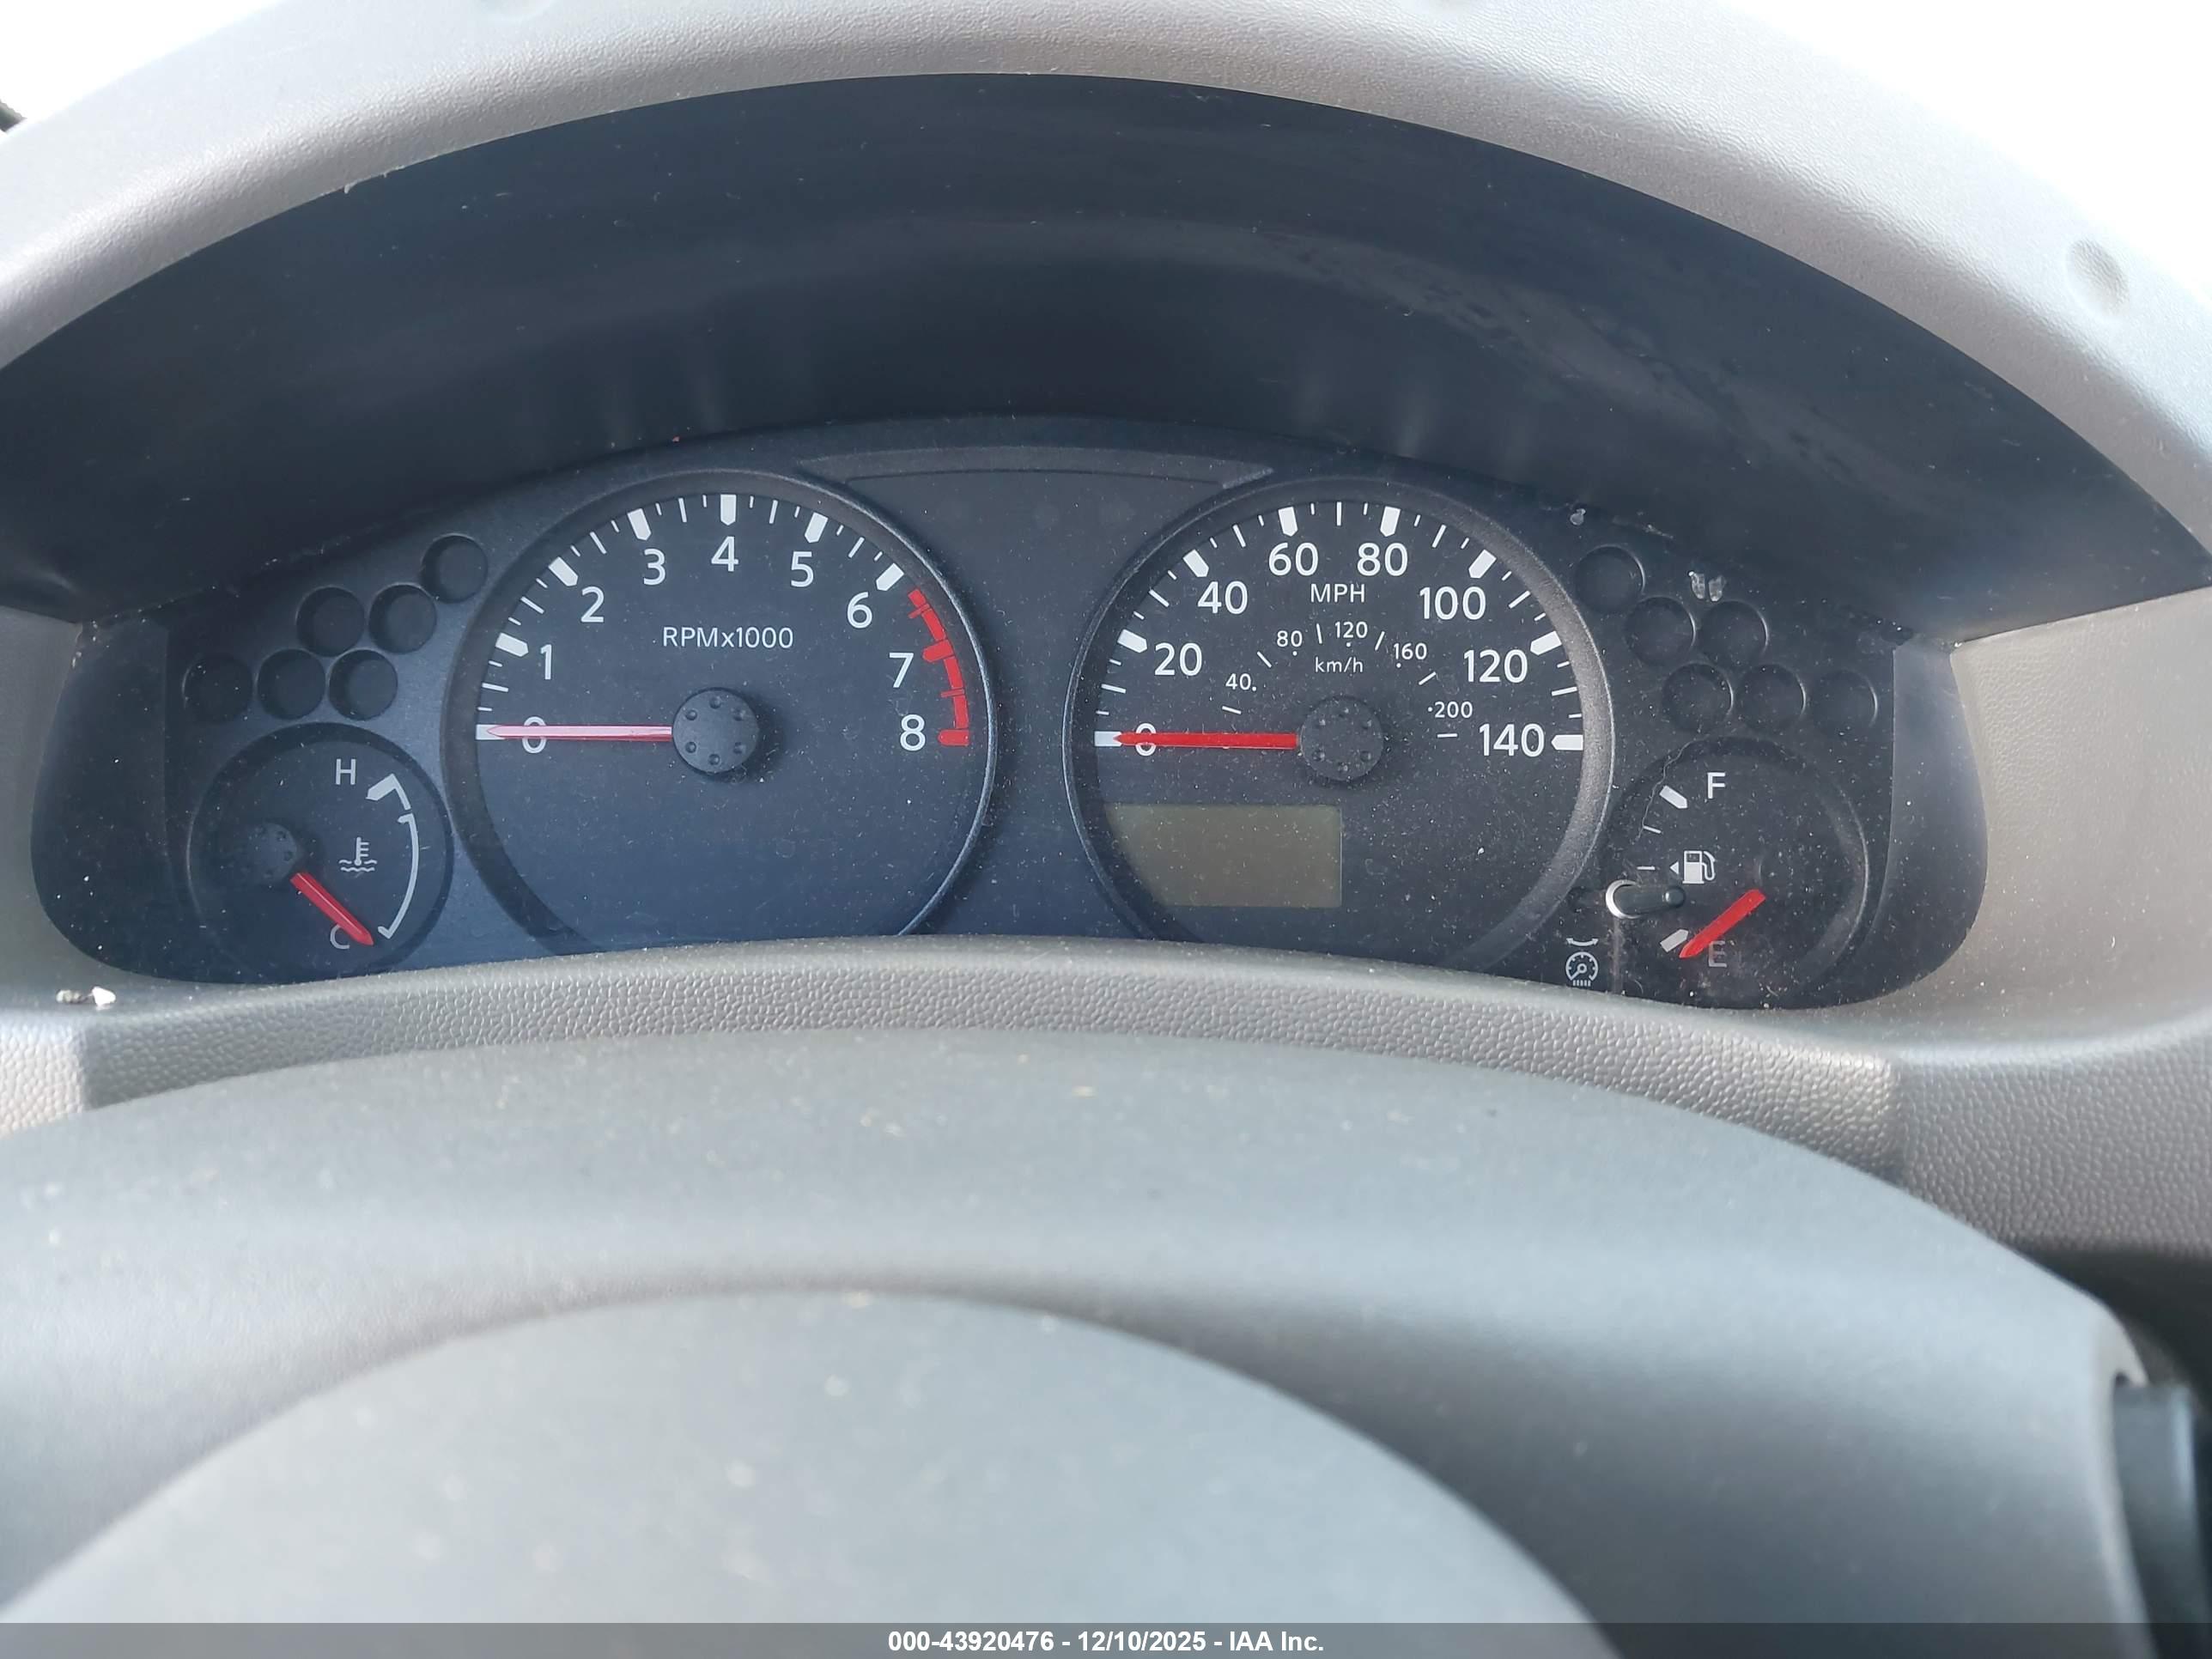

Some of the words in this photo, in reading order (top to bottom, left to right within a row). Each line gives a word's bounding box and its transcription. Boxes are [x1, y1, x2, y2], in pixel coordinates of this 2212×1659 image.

[643, 548, 666, 586] 3
[711, 536, 739, 572] 4
[791, 550, 814, 587] 5
[1268, 542, 1319, 576] 60
[1357, 542, 1408, 576] 80
[580, 586, 605, 623] 2
[1197, 580, 1248, 615] 40
[1310, 583, 1365, 603] MPH
[1419, 586, 1486, 620] 100
[847, 592, 872, 629] 6
[663, 626, 793, 648] RPMx1000
[1276, 630, 1303, 647] 80
[1334, 621, 1368, 639] 120
[540, 644, 552, 680] 1
[1154, 642, 1202, 677] 20
[1315, 656, 1363, 672] km/h
[1394, 642, 1427, 660] 160
[1463, 649, 1528, 684] 120
[889, 652, 915, 688] 7
[1225, 672, 1251, 690] 40
[1435, 701, 1473, 719] 200
[521, 716, 547, 753] 0
[900, 714, 926, 751] 8
[1135, 723, 1158, 756] 0
[1479, 723, 1545, 757] 140
[336, 758, 356, 786] H
[1707, 772, 1726, 799] F
[330, 924, 350, 949] C
[1708, 939, 1728, 968] E
